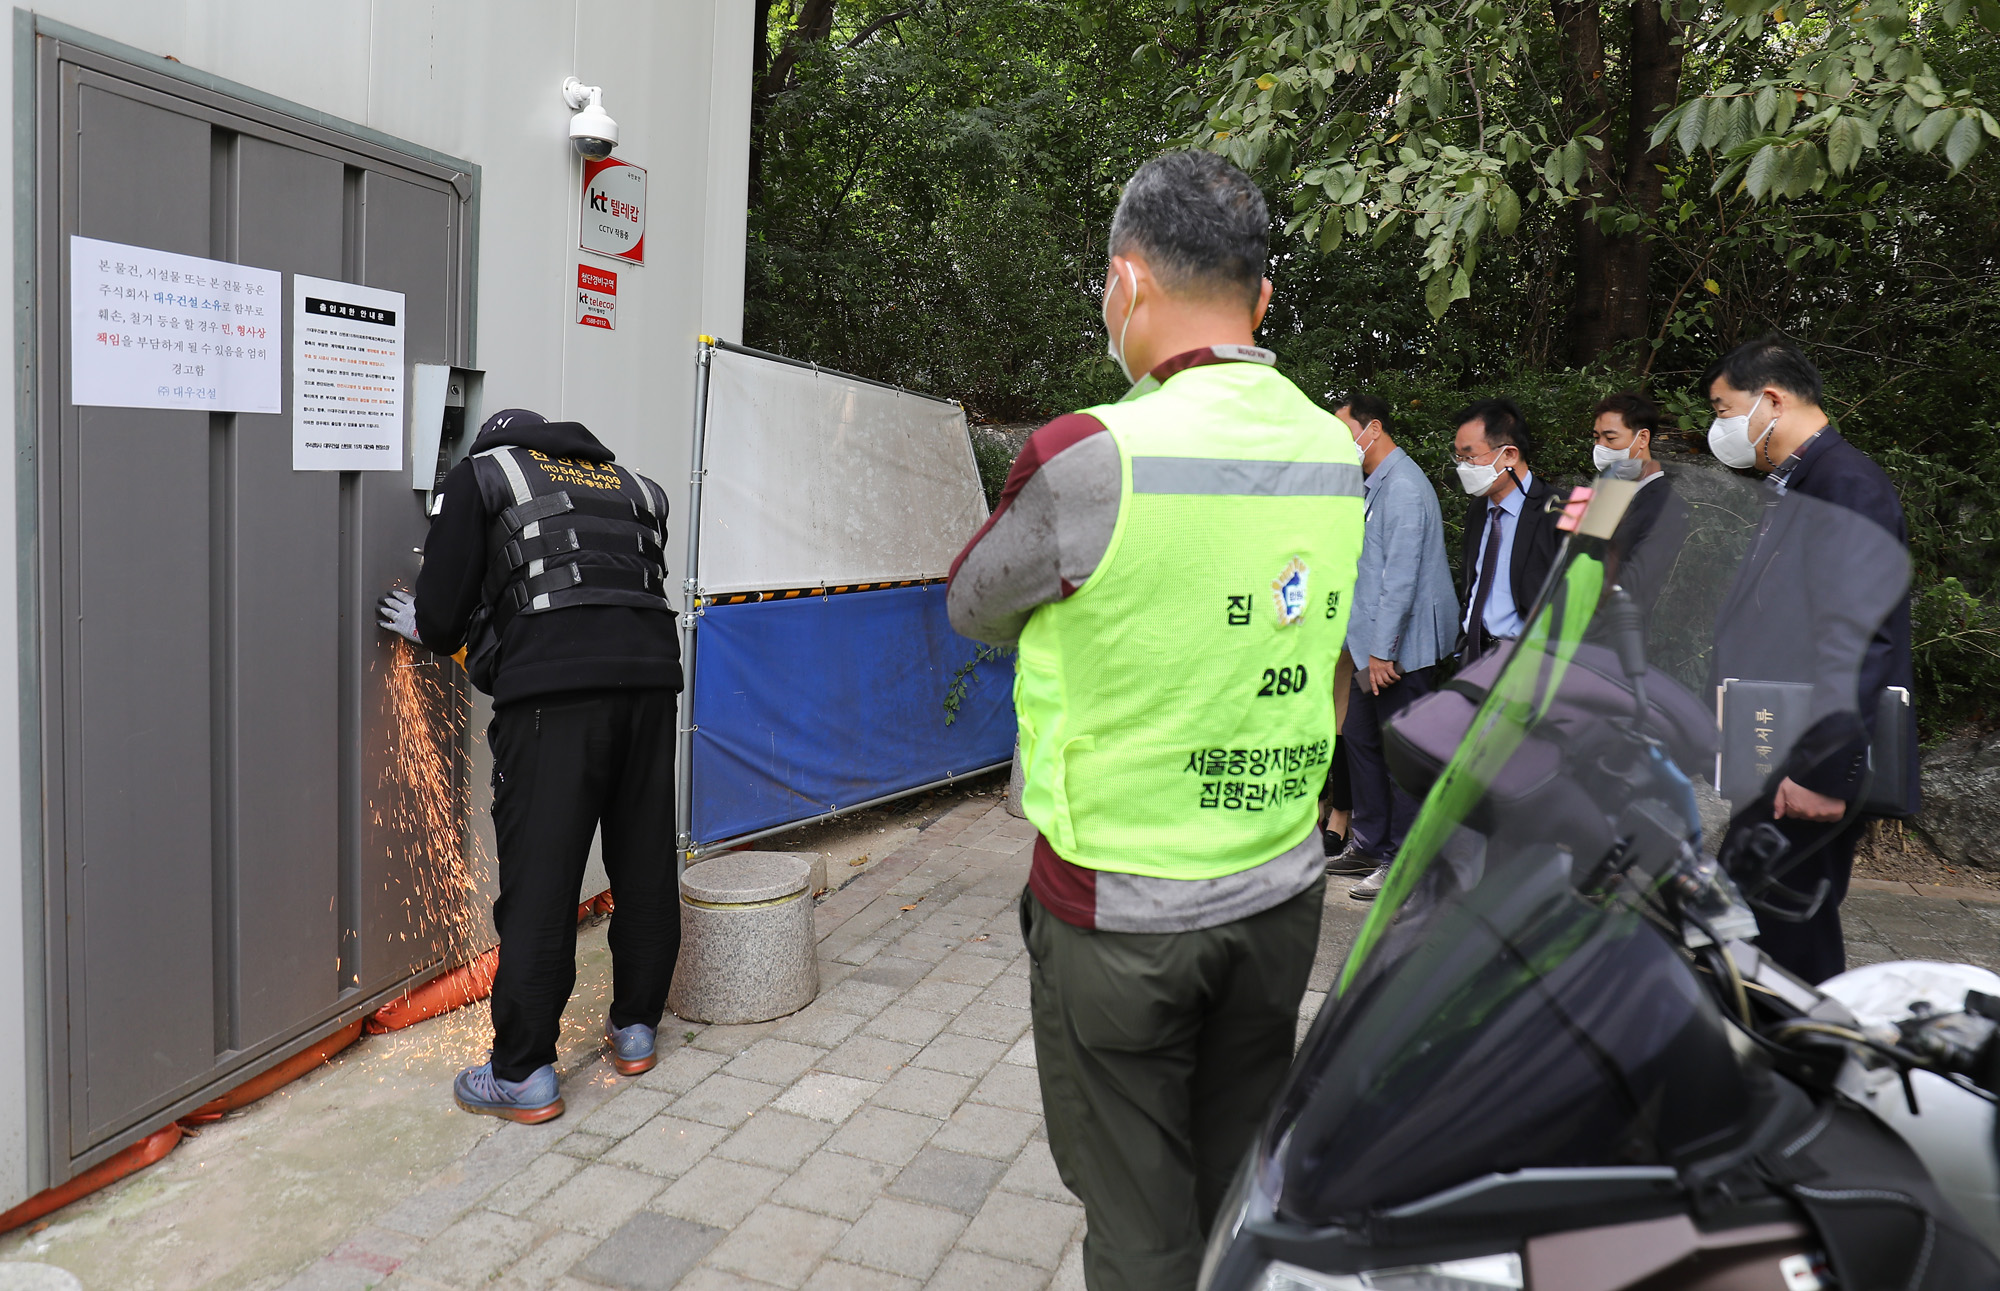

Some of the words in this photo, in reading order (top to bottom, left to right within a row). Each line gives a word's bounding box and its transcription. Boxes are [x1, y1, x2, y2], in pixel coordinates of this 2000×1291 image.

[591, 188, 608, 213] kt
[611, 199, 639, 222] 텔레캅
[599, 225, 613, 234] CCTV
[615, 229, 629, 240] 작동중
[99, 259, 110, 272] 본
[114, 262, 142, 278] 물건,
[146, 268, 180, 283] 시설물
[184, 274, 206, 286] 또는
[210, 277, 219, 289] 본
[223, 279, 241, 291] 건물
[245, 283, 264, 296] 등은
[581, 273, 614, 289] 첨단경비구역
[99, 284, 149, 300] 주식회사
[154, 292, 198, 308] 대우건설
[201, 299, 230, 312] 소유로
[235, 304, 264, 316] 함부로
[319, 303, 355, 316] 출입제한
[360, 310, 384, 321] 안내문
[579, 292, 588, 304] kt
[590, 298, 614, 311] telecop
[99, 309, 126, 323] 훼손,
[130, 312, 153, 326] 철거
[157, 316, 179, 330] 등을
[184, 320, 194, 331] 할
[198, 321, 218, 333] 경우
[221, 324, 234, 335] 민,
[237, 326, 266, 339] 형사상
[586, 318, 606, 326] 1588-0112
[96, 332, 132, 347] 책임을
[137, 337, 184, 352] 부담하게
[188, 343, 198, 354] 될
[201, 344, 212, 354] 수
[215, 345, 244, 358] 있음을
[248, 349, 266, 360] 엄히
[172, 364, 205, 376] 경고함
[174, 386, 216, 399] 대우건설
[1227, 594, 1252, 625] 집
[1326, 591, 1340, 619] 행
[1257, 665, 1308, 696] 280
[1200, 777, 1308, 811] 집행관사무소
